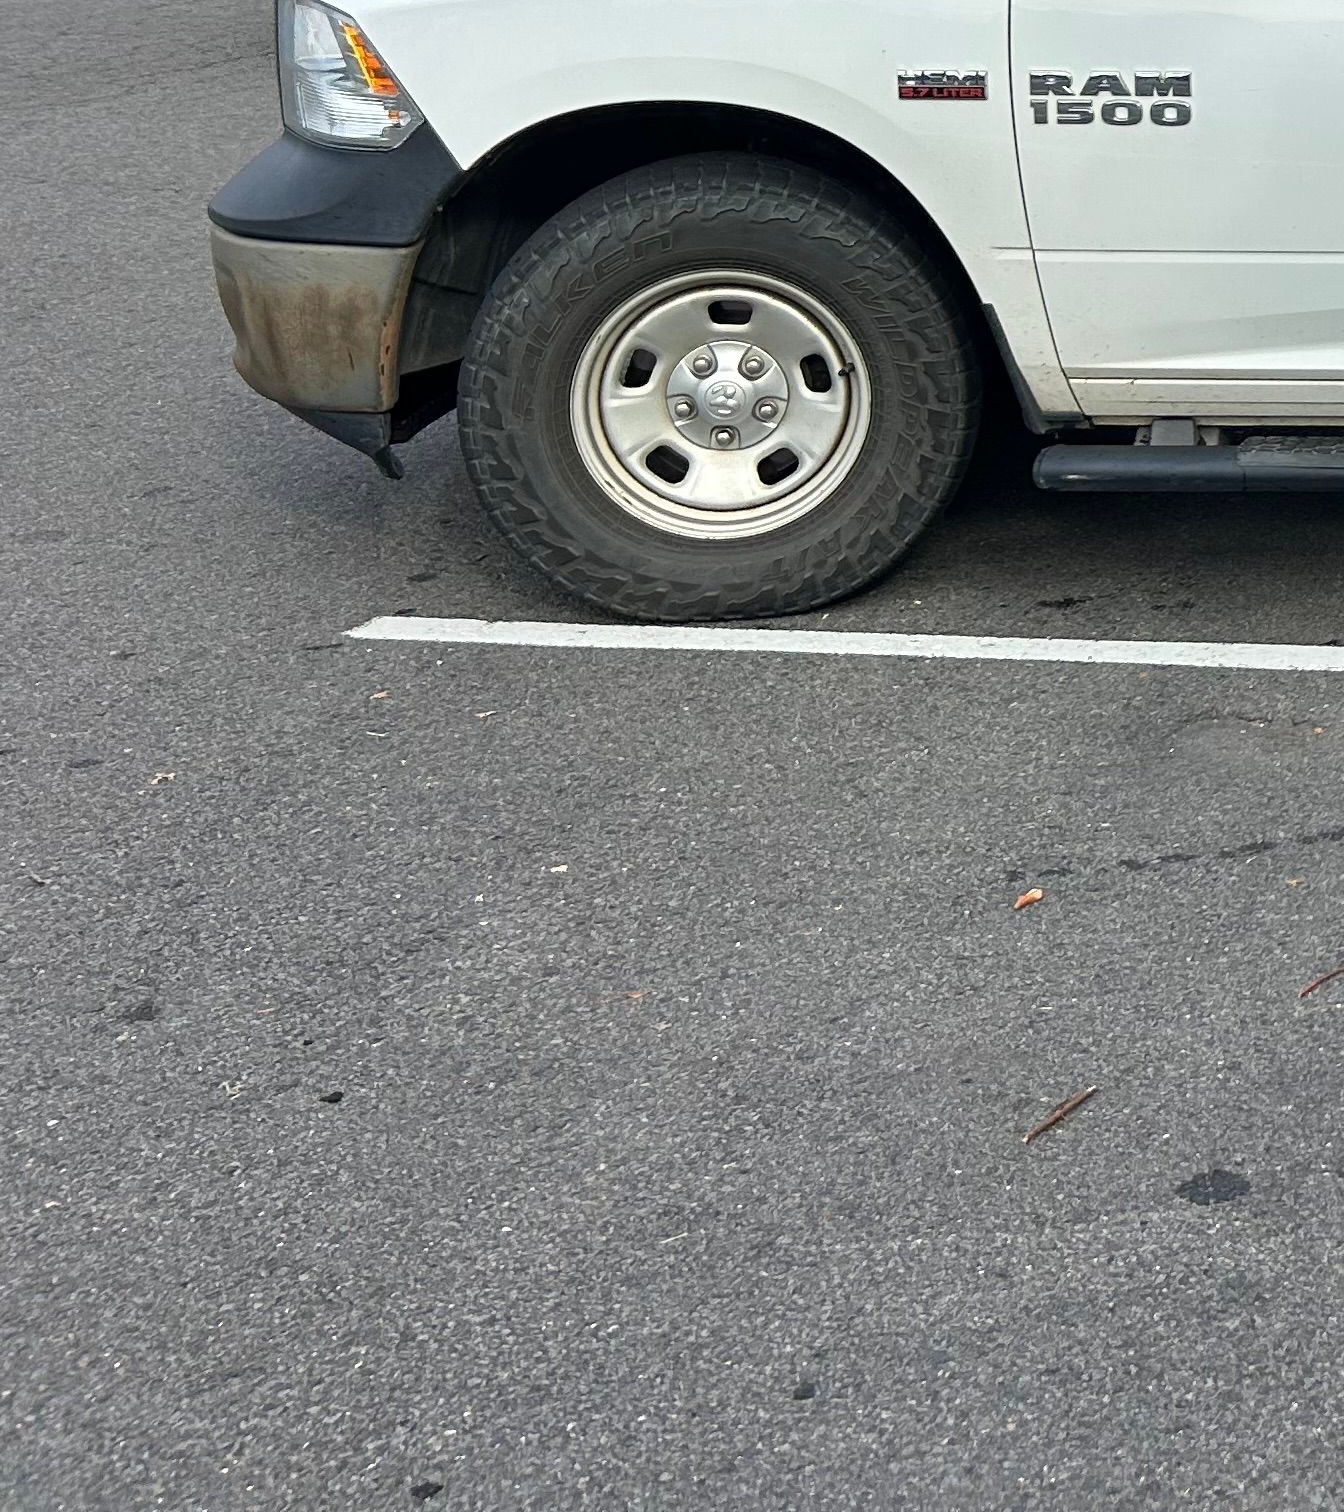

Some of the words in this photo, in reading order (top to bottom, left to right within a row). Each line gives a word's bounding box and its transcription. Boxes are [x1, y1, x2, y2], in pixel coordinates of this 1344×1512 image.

[896, 68, 988, 86] HEMI
[1028, 69, 1193, 97] RAM
[900, 87, 929, 98] 5.7
[931, 87, 983, 98] LITER
[1029, 98, 1193, 127] 1500
